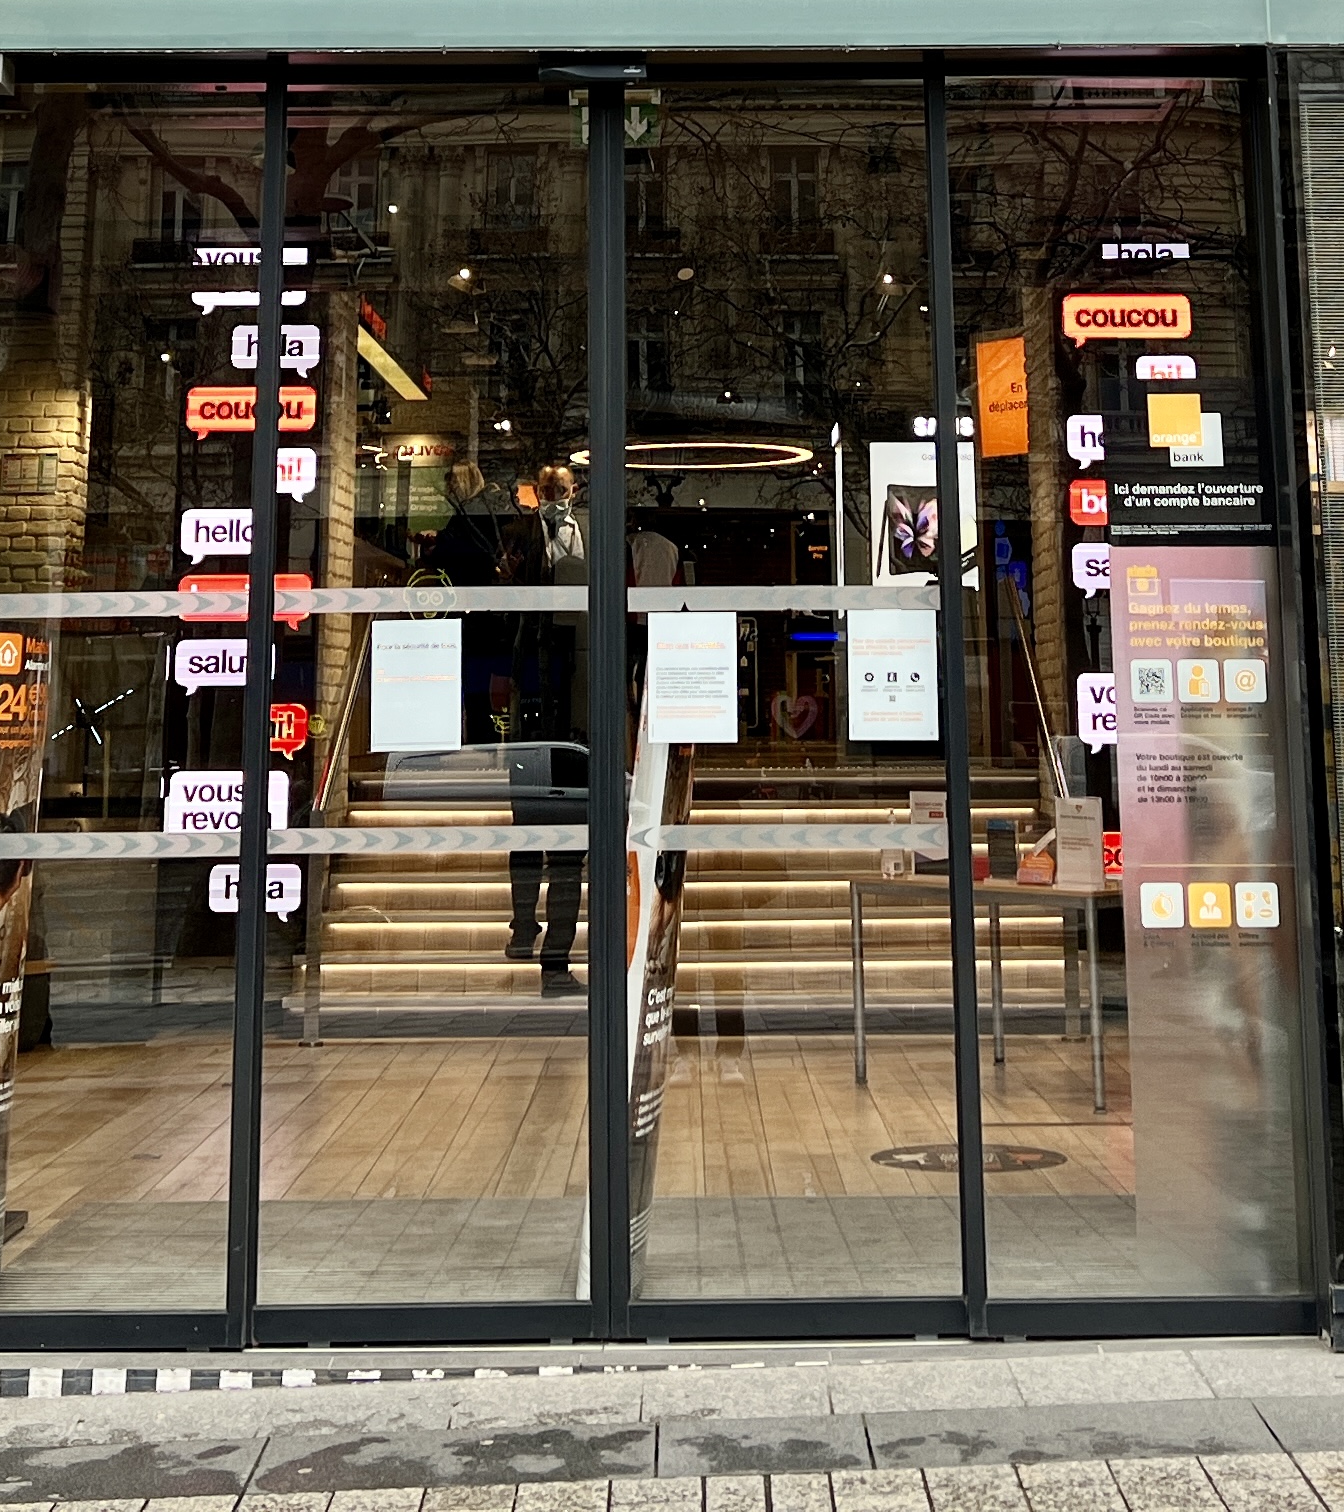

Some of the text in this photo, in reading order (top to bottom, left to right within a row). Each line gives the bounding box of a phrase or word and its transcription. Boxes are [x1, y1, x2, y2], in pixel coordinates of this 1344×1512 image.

[1075, 305, 1178, 329] coucou
[199, 400, 304, 420] couu
[1152, 432, 1197, 445] orange
[1173, 451, 1205, 462] bank
[1128, 602, 1180, 616] Gagnez
[1184, 602, 1201, 614] du
[1179, 618, 1264, 631] rendez-vous
[1130, 634, 1265, 649] avec votre boutique
[188, 649, 248, 674] salu
